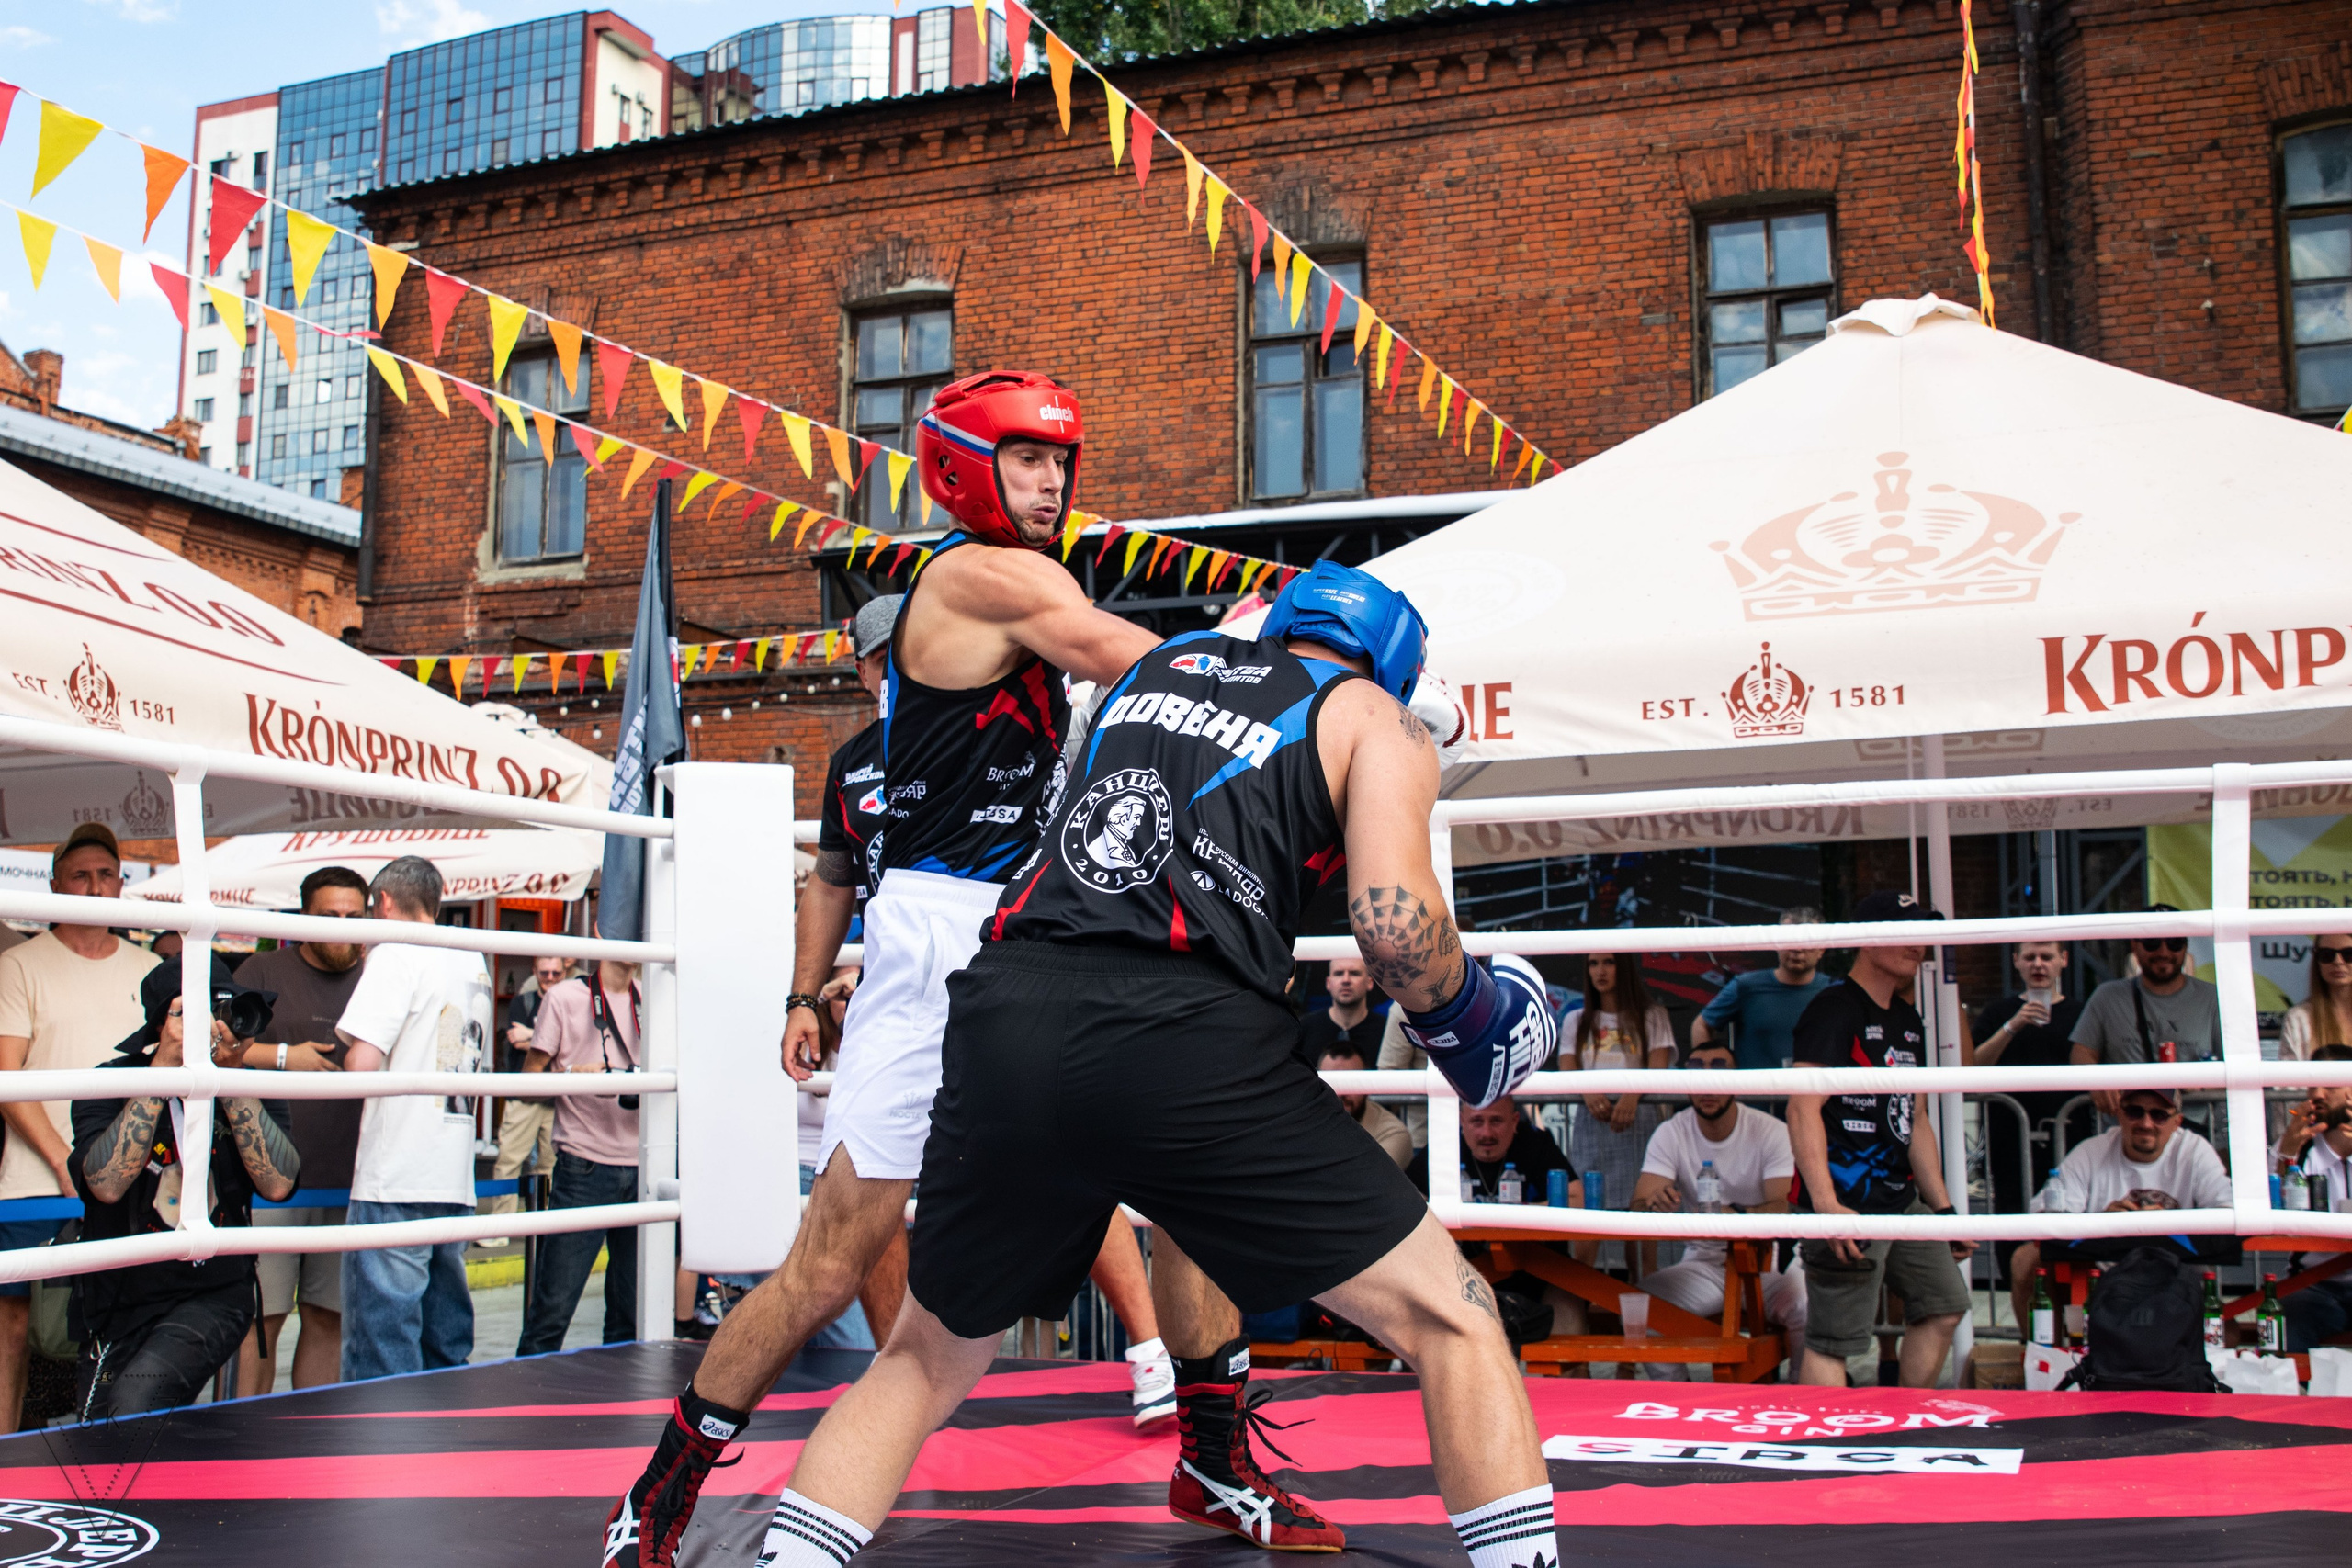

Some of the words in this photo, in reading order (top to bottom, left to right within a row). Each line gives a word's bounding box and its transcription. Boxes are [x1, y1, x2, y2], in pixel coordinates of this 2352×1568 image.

[1039, 402, 1075, 423] clinch
[2041, 611, 2352, 715] KRÓNP
[12, 672, 58, 700] EST.
[130, 700, 175, 725] 1581
[1642, 698, 1709, 721] EST.
[1830, 684, 1905, 710] 1581
[1075, 859, 1148, 886] 2010
[1613, 1402, 1992, 1428] BROOM
[707, 1423, 730, 1438] asics
[1731, 1425, 1844, 1437] GIN
